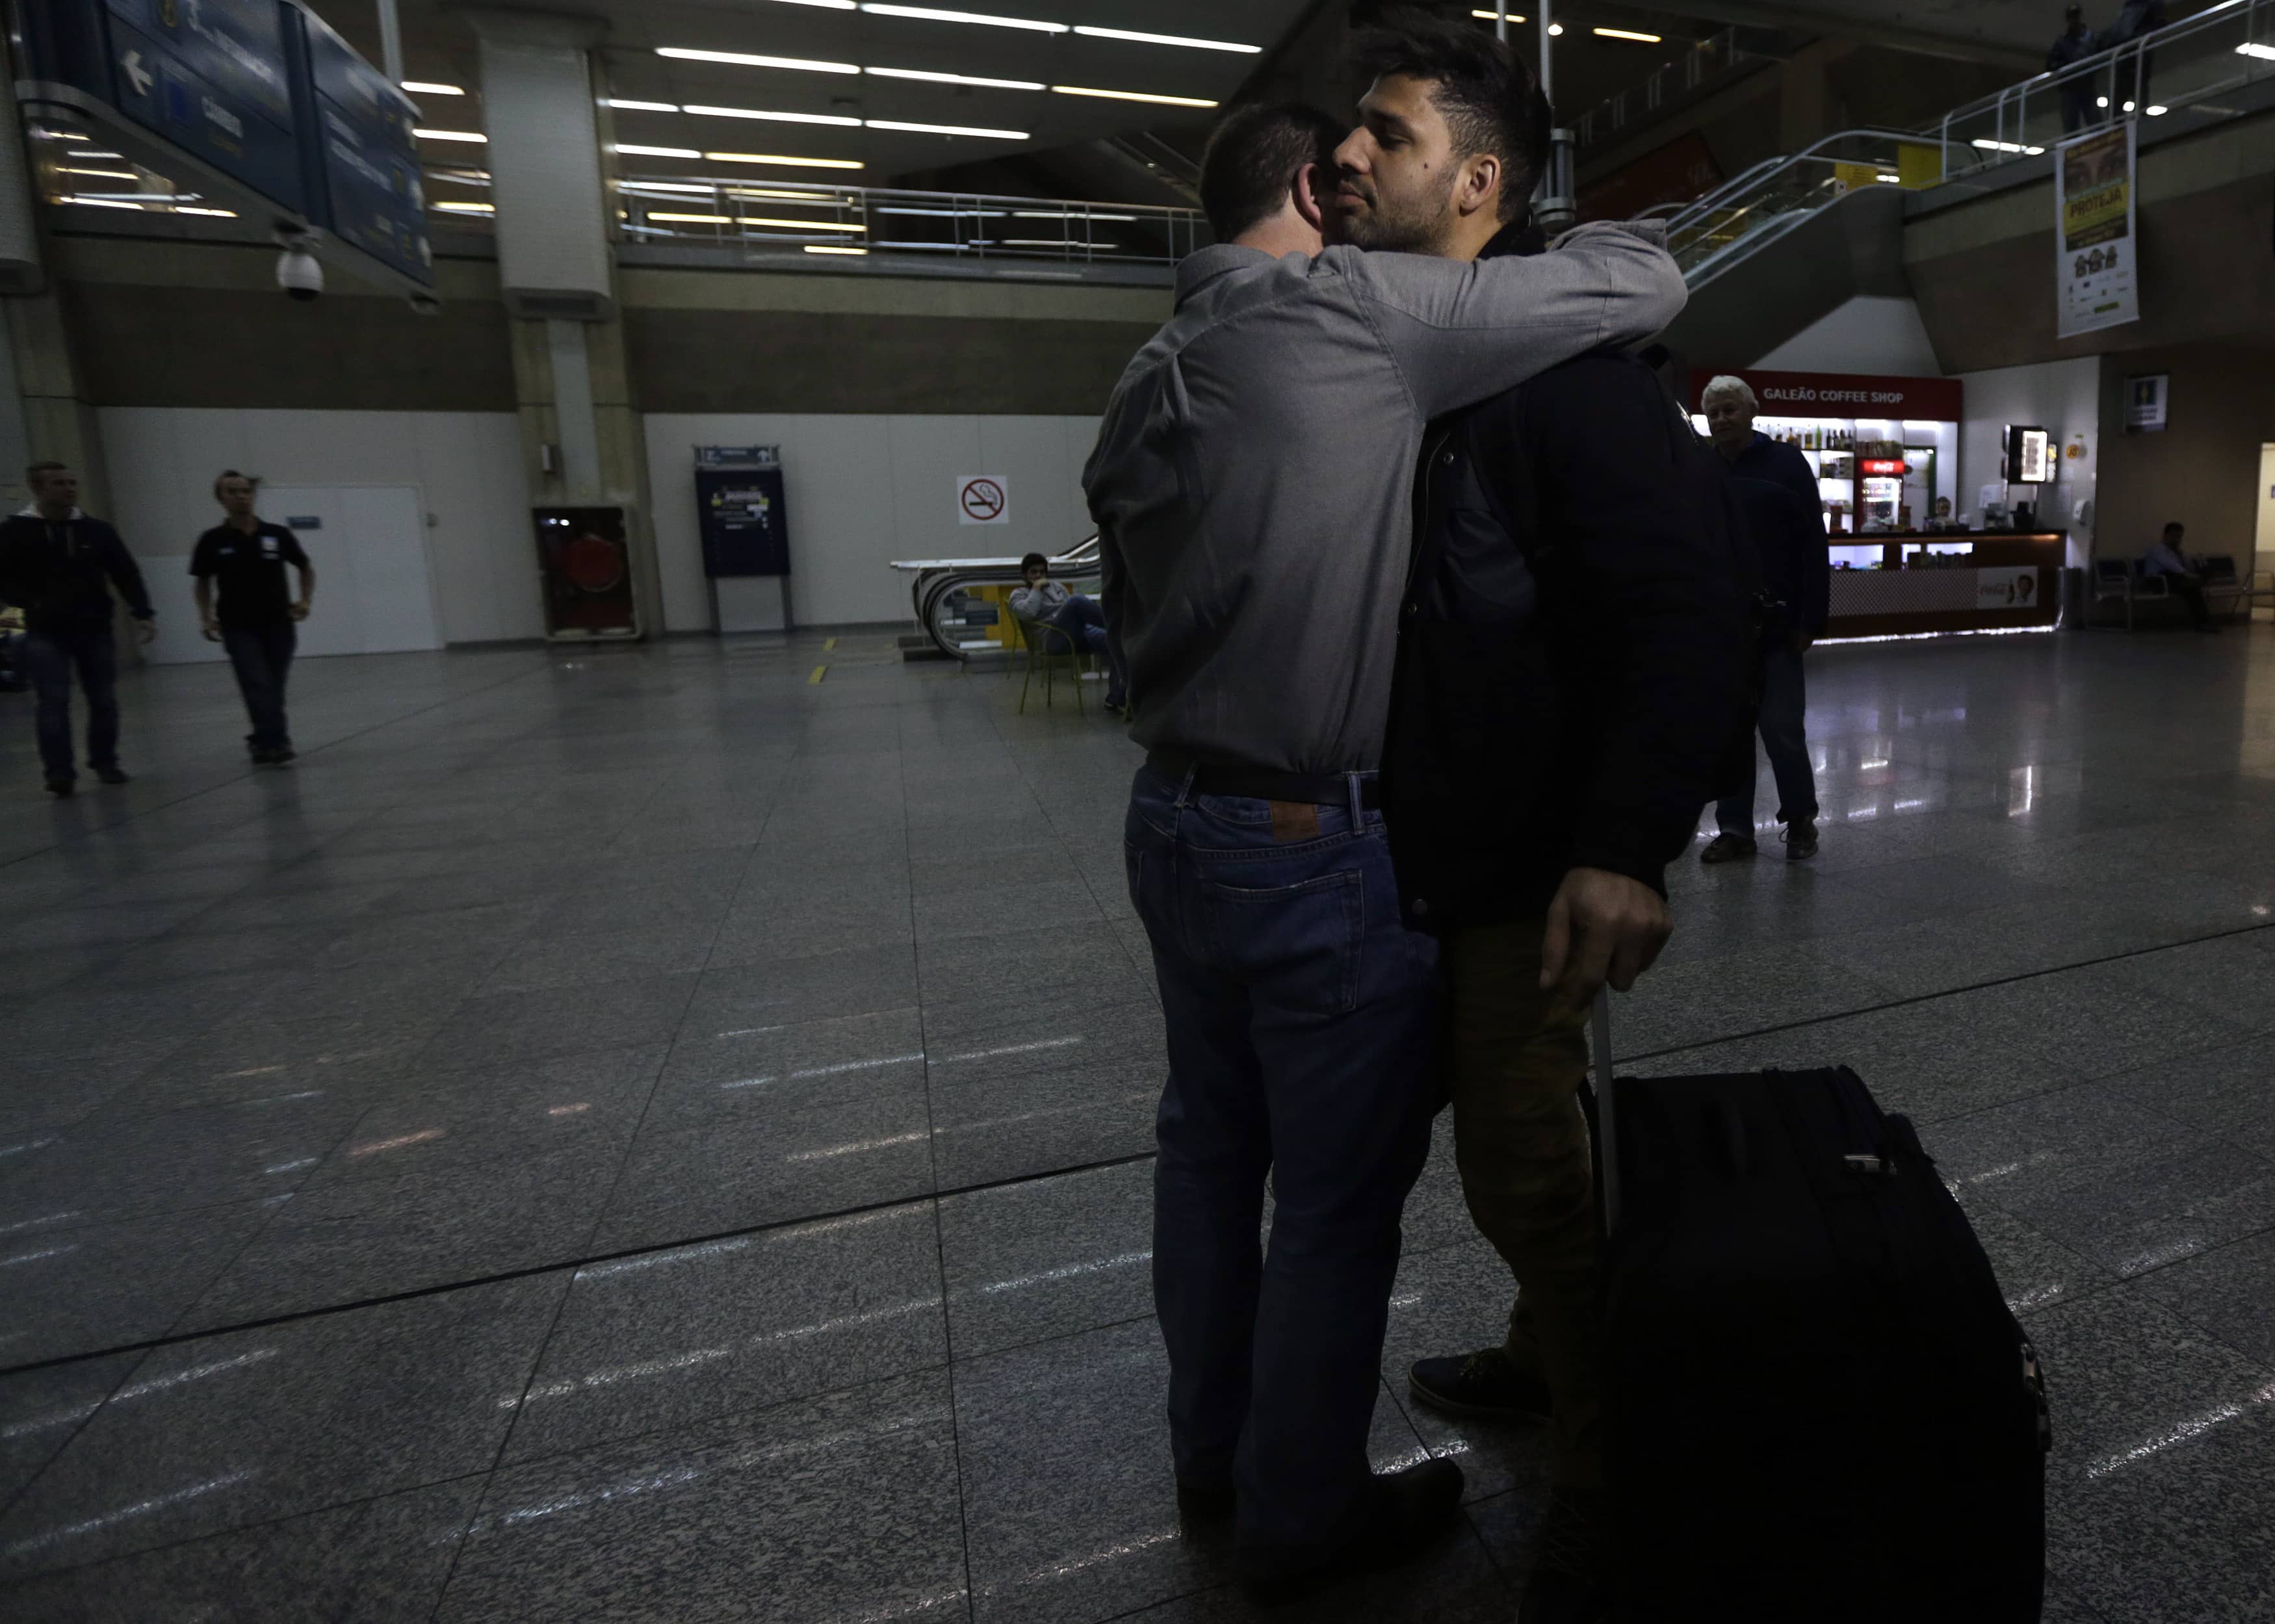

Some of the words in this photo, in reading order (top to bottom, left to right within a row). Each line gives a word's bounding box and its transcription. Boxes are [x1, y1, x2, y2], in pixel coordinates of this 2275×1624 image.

[2070, 188, 2122, 218] PROTEJA
[1763, 387, 1817, 400] GALEÃO
[1819, 390, 1867, 403] COFFEE
[1870, 392, 1904, 404] SHOP
